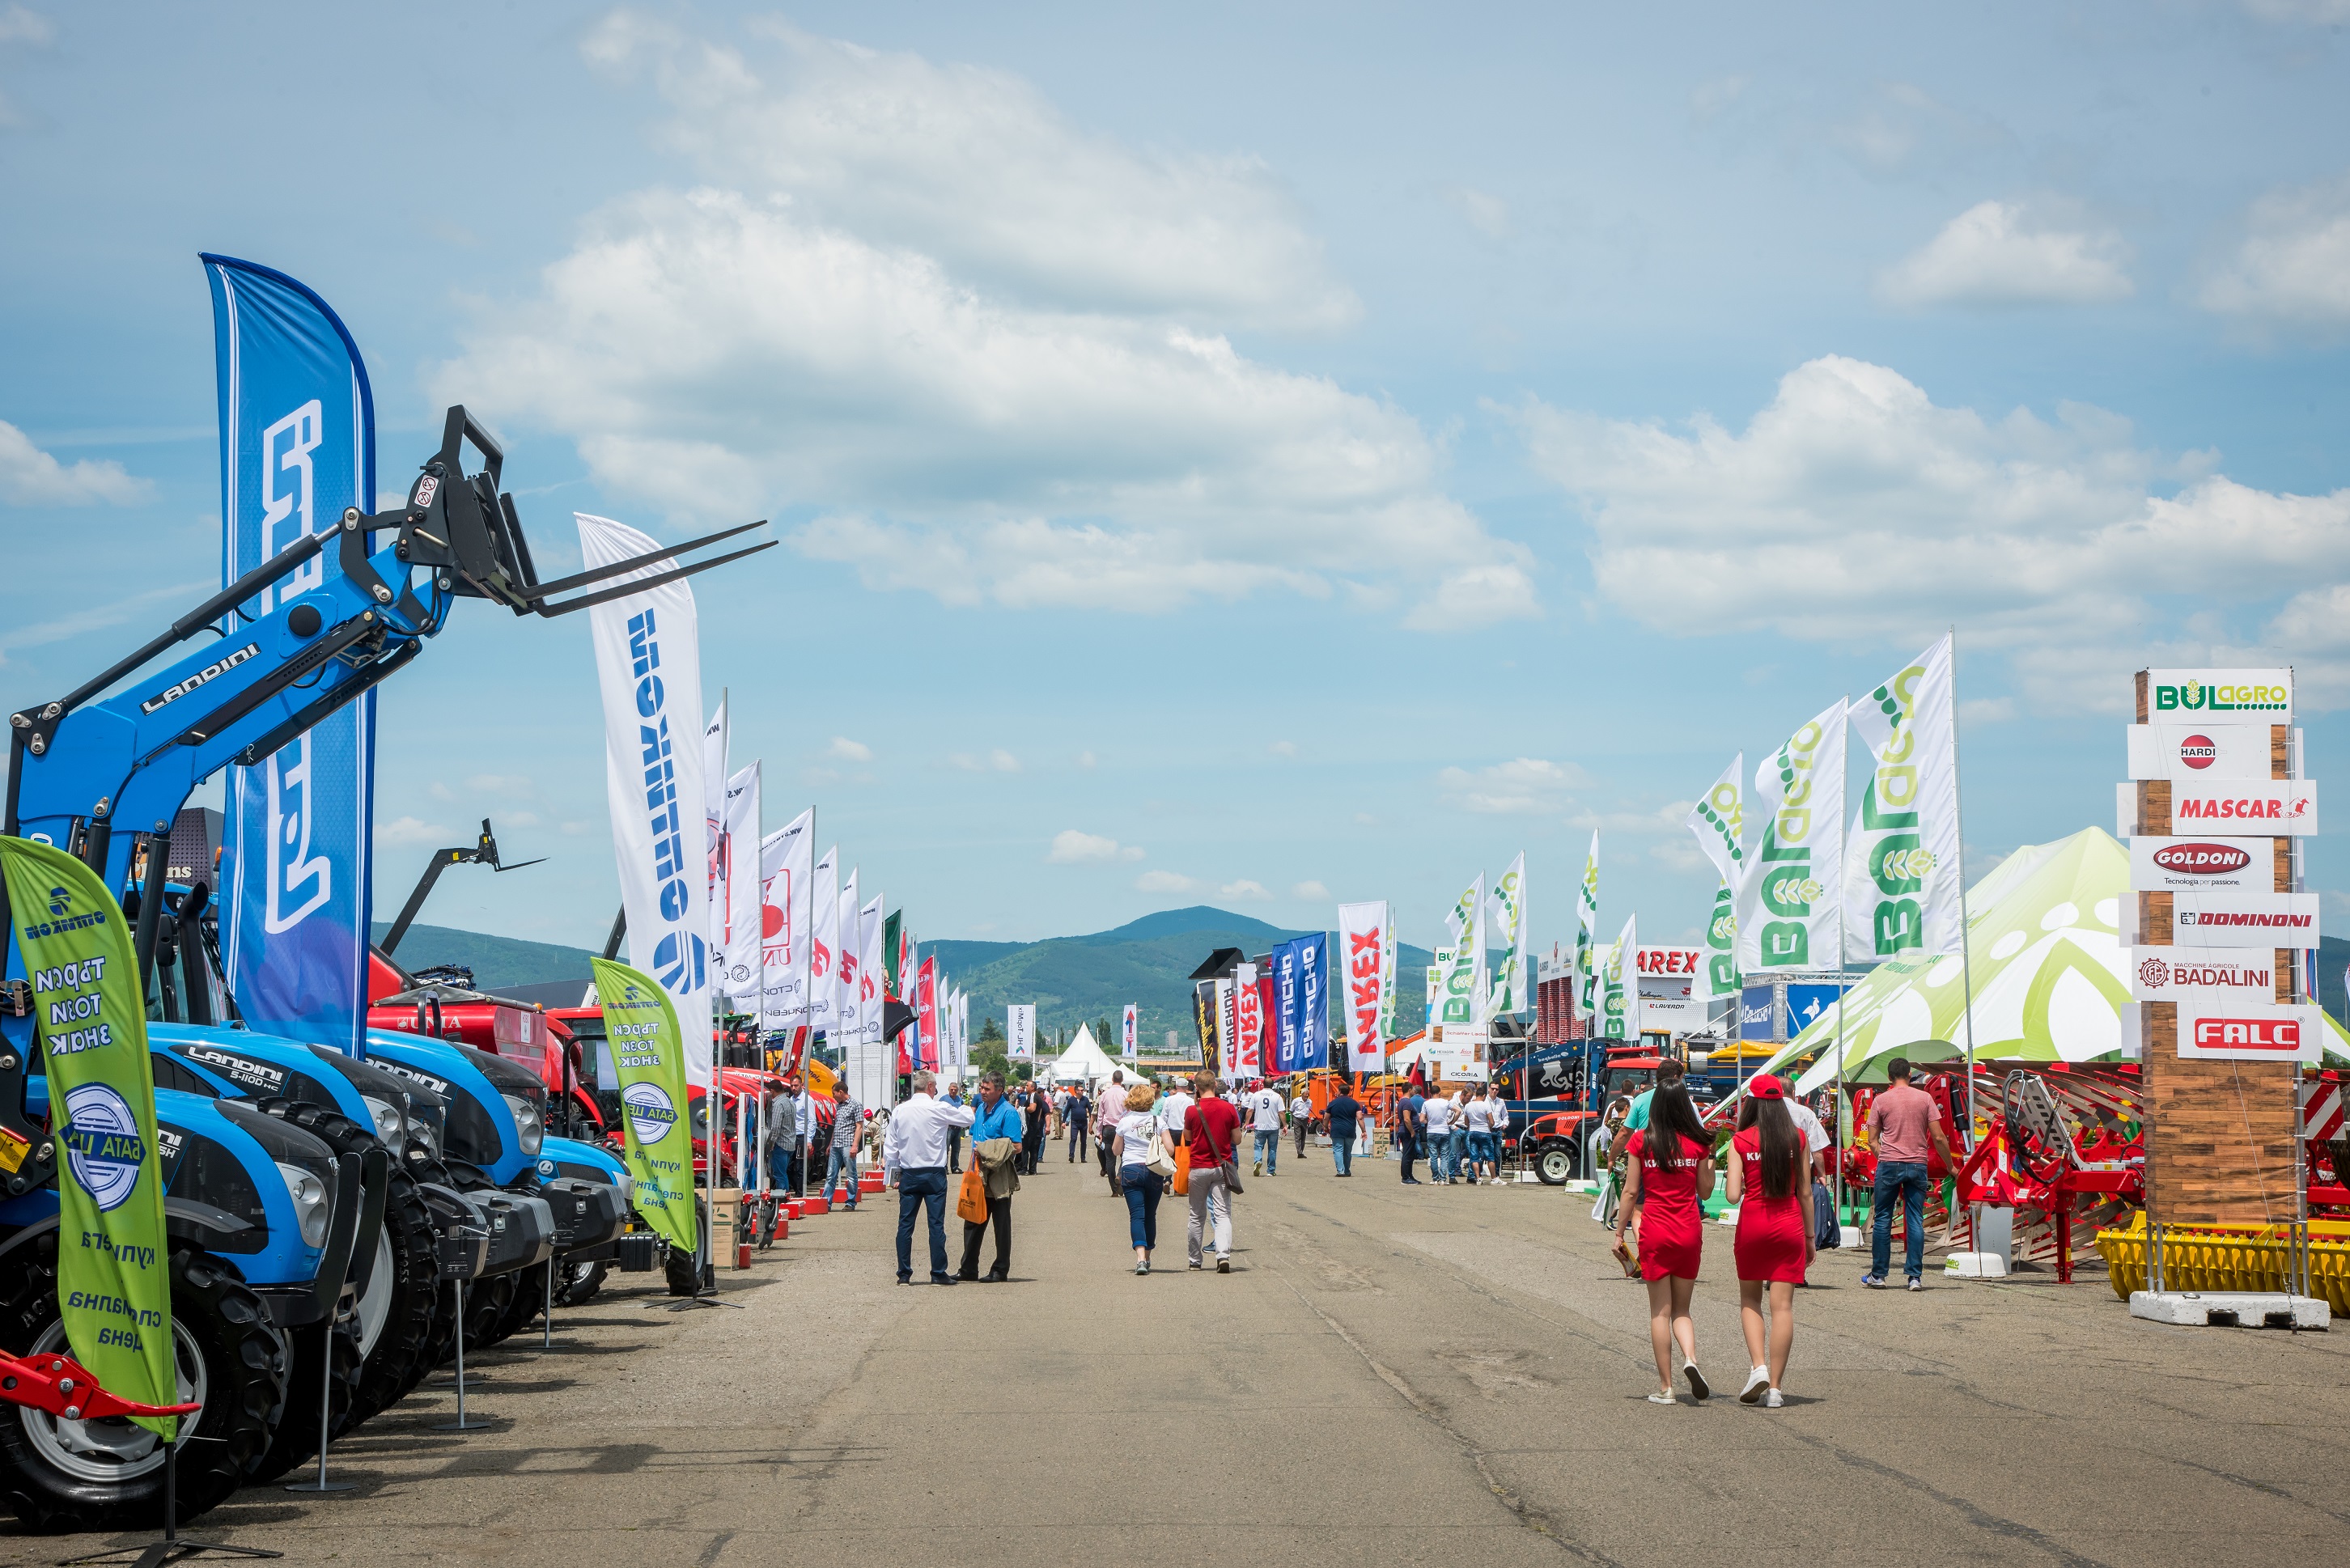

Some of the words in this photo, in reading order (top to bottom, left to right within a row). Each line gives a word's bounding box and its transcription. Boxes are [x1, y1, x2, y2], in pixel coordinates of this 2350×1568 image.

[142, 643, 258, 712] LANDINI
[2180, 747, 2216, 757] HARDI
[2179, 799, 2281, 818] MASCAR
[2157, 851, 2246, 867] GOLDONI
[2164, 878, 2199, 887] Tecnologia
[2198, 913, 2312, 927] DOMINONI
[1637, 950, 1700, 974] AREX
[2174, 968, 2268, 986] BADALINI
[2199, 1021, 2297, 1045] FALC
[189, 1046, 283, 1082] LANDINI
[1262, 1097, 1270, 1109] 9
[1644, 1158, 1699, 1168] КИОВЕЦ
